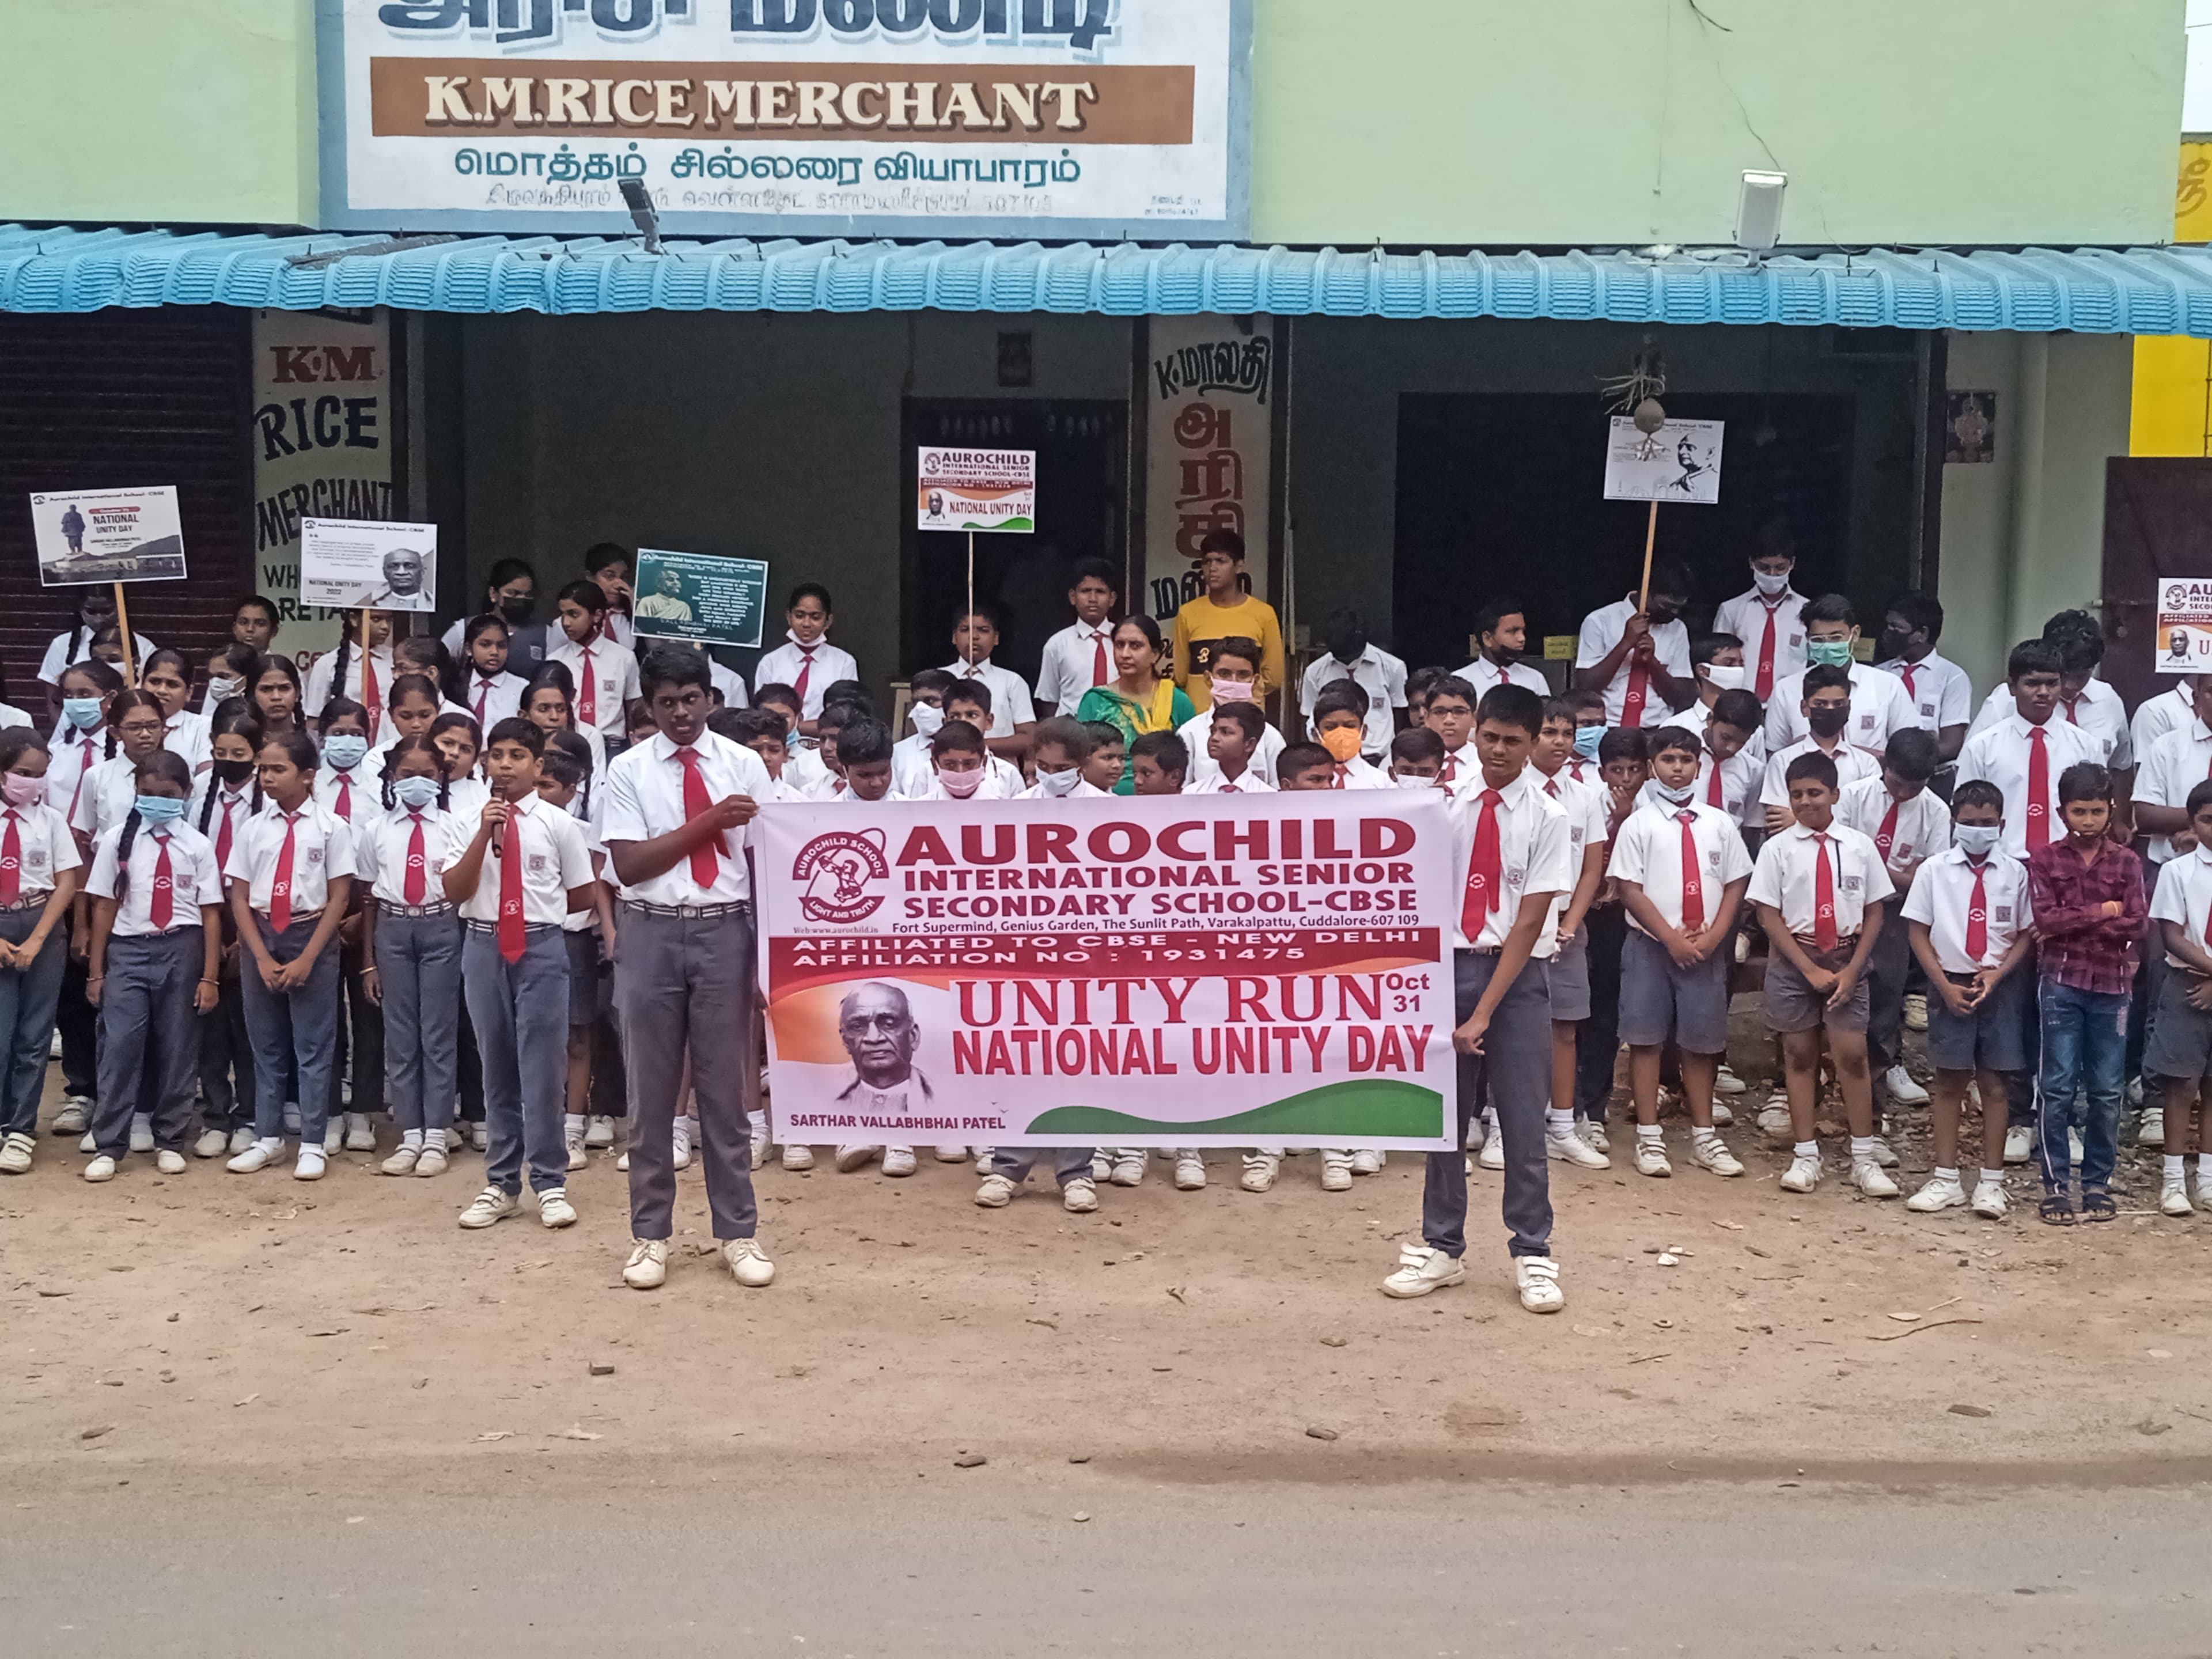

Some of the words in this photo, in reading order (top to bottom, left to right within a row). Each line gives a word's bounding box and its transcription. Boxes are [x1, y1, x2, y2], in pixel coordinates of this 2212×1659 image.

[703, 79, 1095, 131] MERCHANT
[455, 142, 647, 184] மொத்தம்
[671, 146, 863, 185] சில்லரை
[874, 149, 1081, 187] வியாபாரம்
[253, 395, 378, 461] RICE
[942, 453, 1031, 465] AUROCHILD
[93, 514, 139, 524] NATIONAL
[949, 502, 988, 515] NATIONAL
[990, 503, 1014, 516] UNITY
[1017, 504, 1032, 516] DAY
[895, 818, 1416, 866] AUROCHILD
[798, 838, 848, 876] AUROCHILD
[850, 839, 884, 876] SCHOOL
[904, 865, 1240, 892] INTERNATIONAL
[1257, 862, 1414, 886] SENIOR
[904, 893, 1136, 919] SECONDARY
[1151, 889, 1417, 914] SCHOOL-CBSE
[893, 922, 920, 934] Fort
[923, 921, 998, 935] Supermind,
[1001, 921, 1044, 932] Genius
[1047, 919, 1099, 932] Garden,
[1102, 918, 1126, 930] The
[1130, 917, 1167, 930] Sunlit
[1171, 918, 1204, 931] Path,
[1207, 916, 1296, 931] Varakalpattu,
[793, 937, 994, 952] AFFILIATED
[1012, 935, 1058, 948] TO
[1076, 934, 1167, 948] CBSE
[1217, 932, 1297, 945] NEW
[1315, 930, 1420, 944] DELHI
[793, 952, 1017, 967] AFFILIATION
[1036, 951, 1090, 964] NO
[1142, 948, 1305, 962] 1931475
[1385, 972, 1430, 990] Oct
[955, 976, 1200, 1027] UNITY
[1223, 974, 1385, 1024] RUN
[1393, 994, 1421, 1013] 31
[952, 1028, 1178, 1076] NATIONAL
[1192, 1025, 1331, 1075] UNITY
[1347, 1024, 1434, 1073] DAY
[790, 1114, 857, 1127] SARTHAR
[859, 1115, 959, 1129] VALLABHBHAI
[963, 1116, 1006, 1130] PATEL
